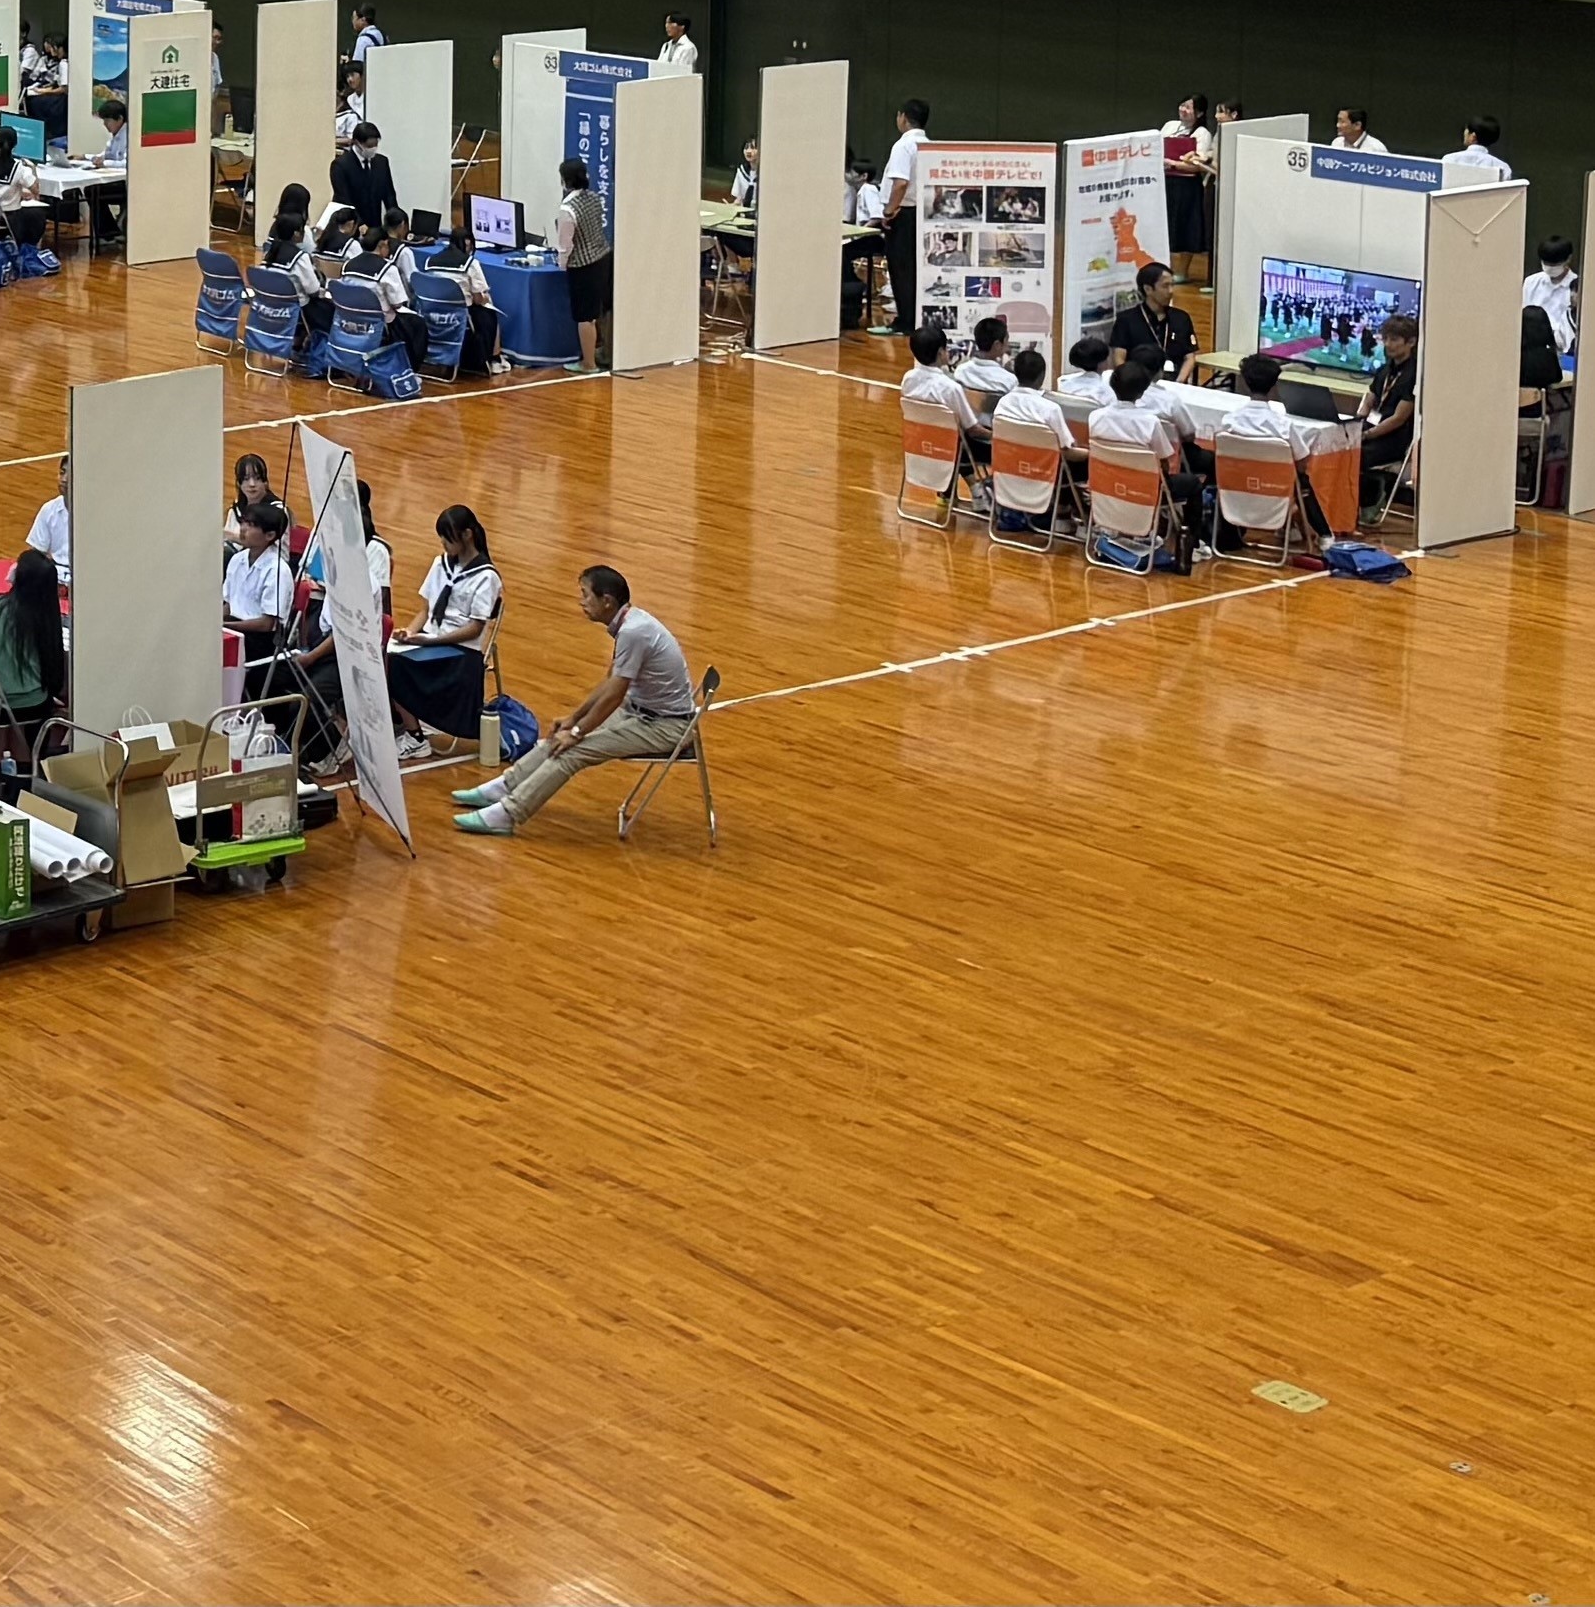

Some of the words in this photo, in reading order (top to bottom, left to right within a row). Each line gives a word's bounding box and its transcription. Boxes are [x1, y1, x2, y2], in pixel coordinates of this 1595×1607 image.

[150, 74, 190, 90] 大建住宅
[1288, 150, 1307, 168] 35
